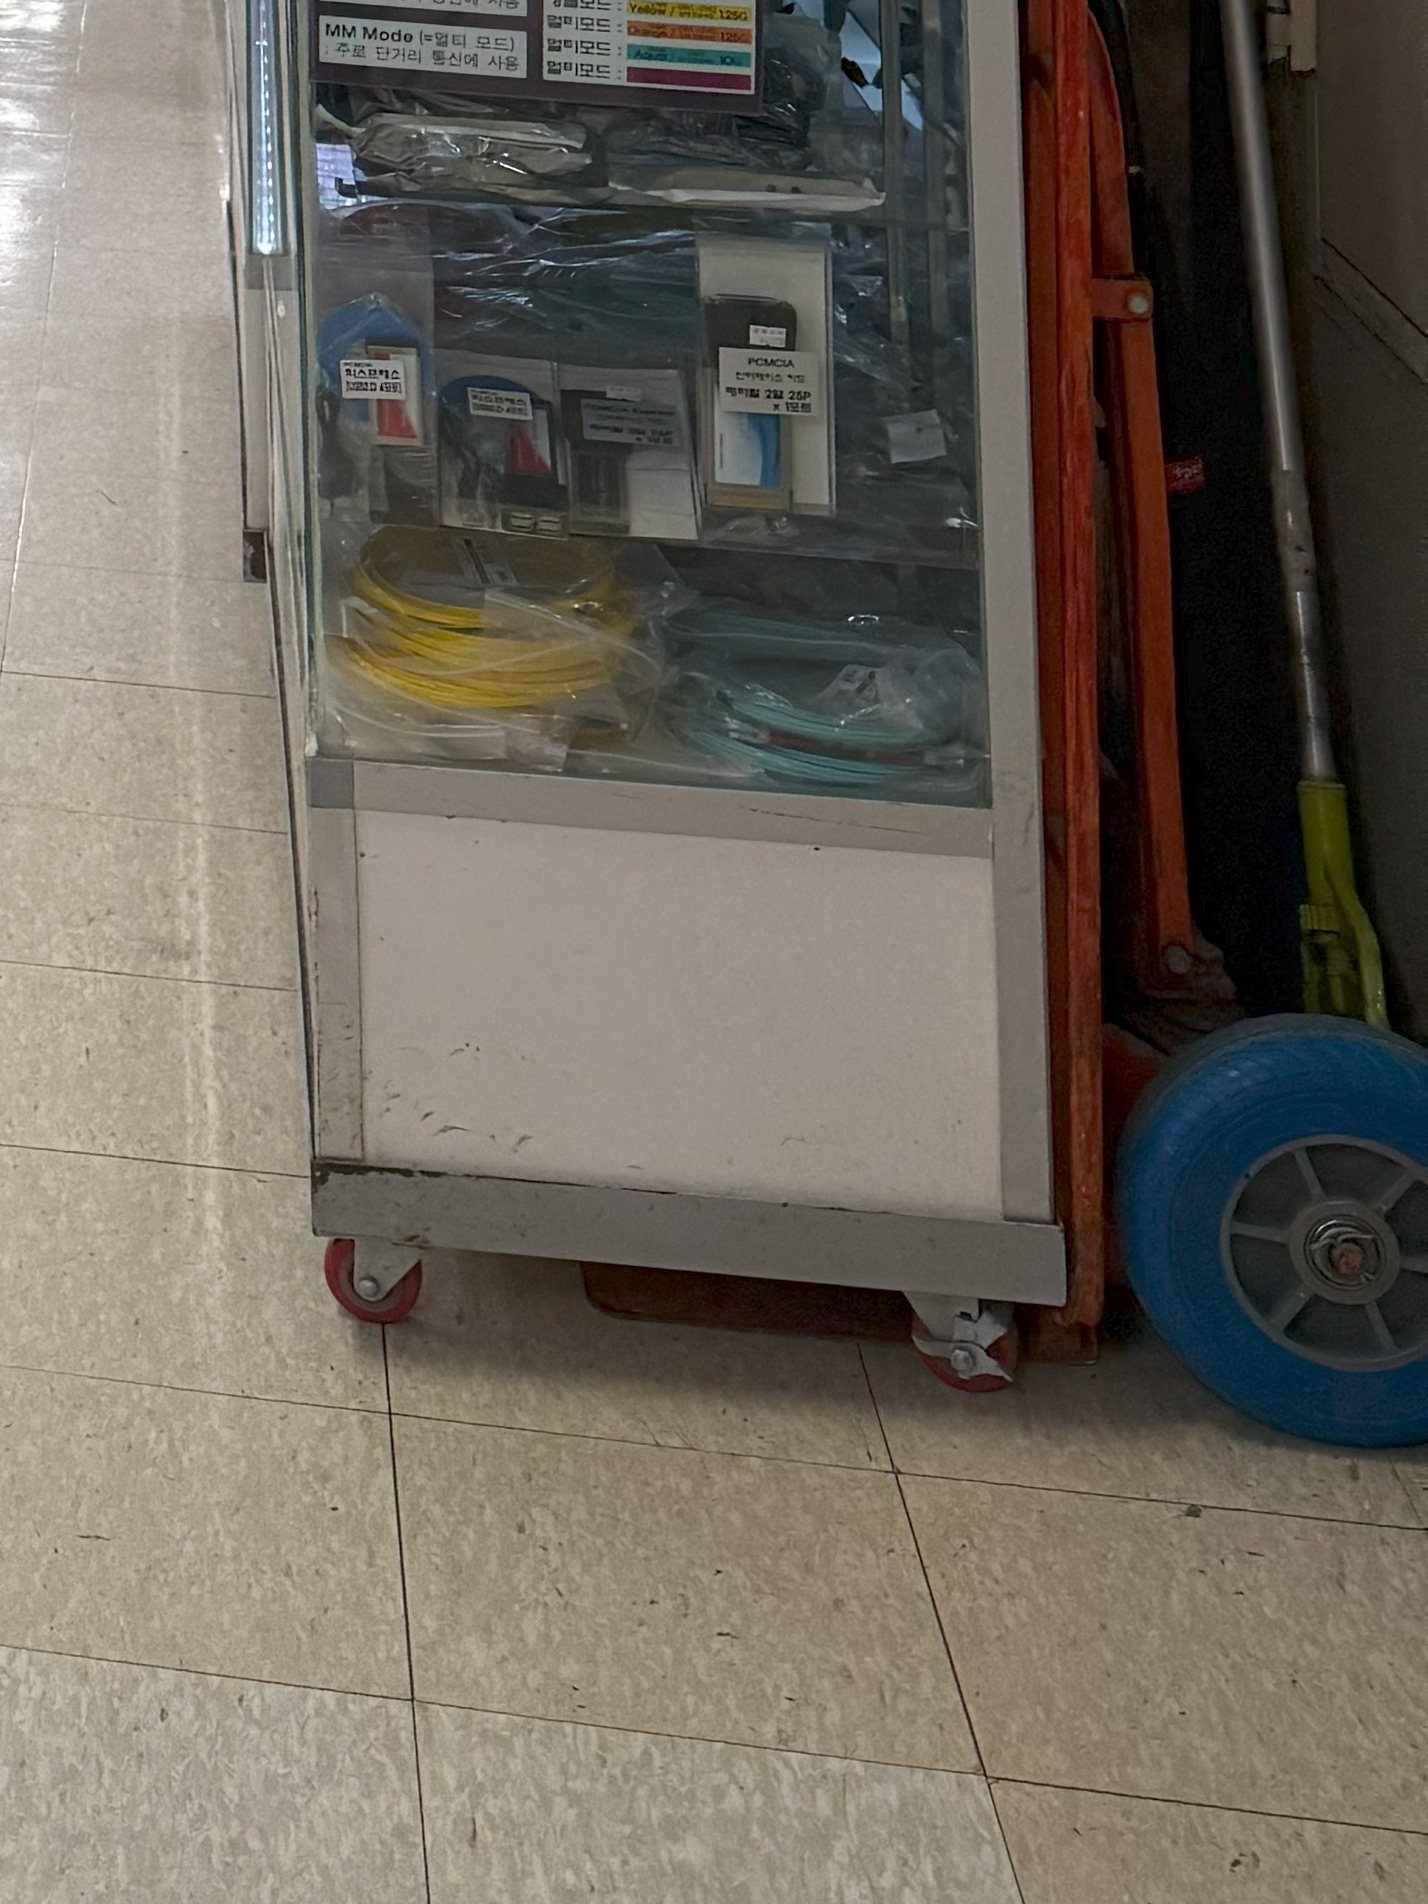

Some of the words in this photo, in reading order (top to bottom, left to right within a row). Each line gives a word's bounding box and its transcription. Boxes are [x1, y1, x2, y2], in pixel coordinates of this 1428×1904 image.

[325, 23, 357, 39] MM
[362, 26, 414, 44] Mode
[487, 54, 520, 72] 사용
[748, 357, 795, 369] PCMCIA
